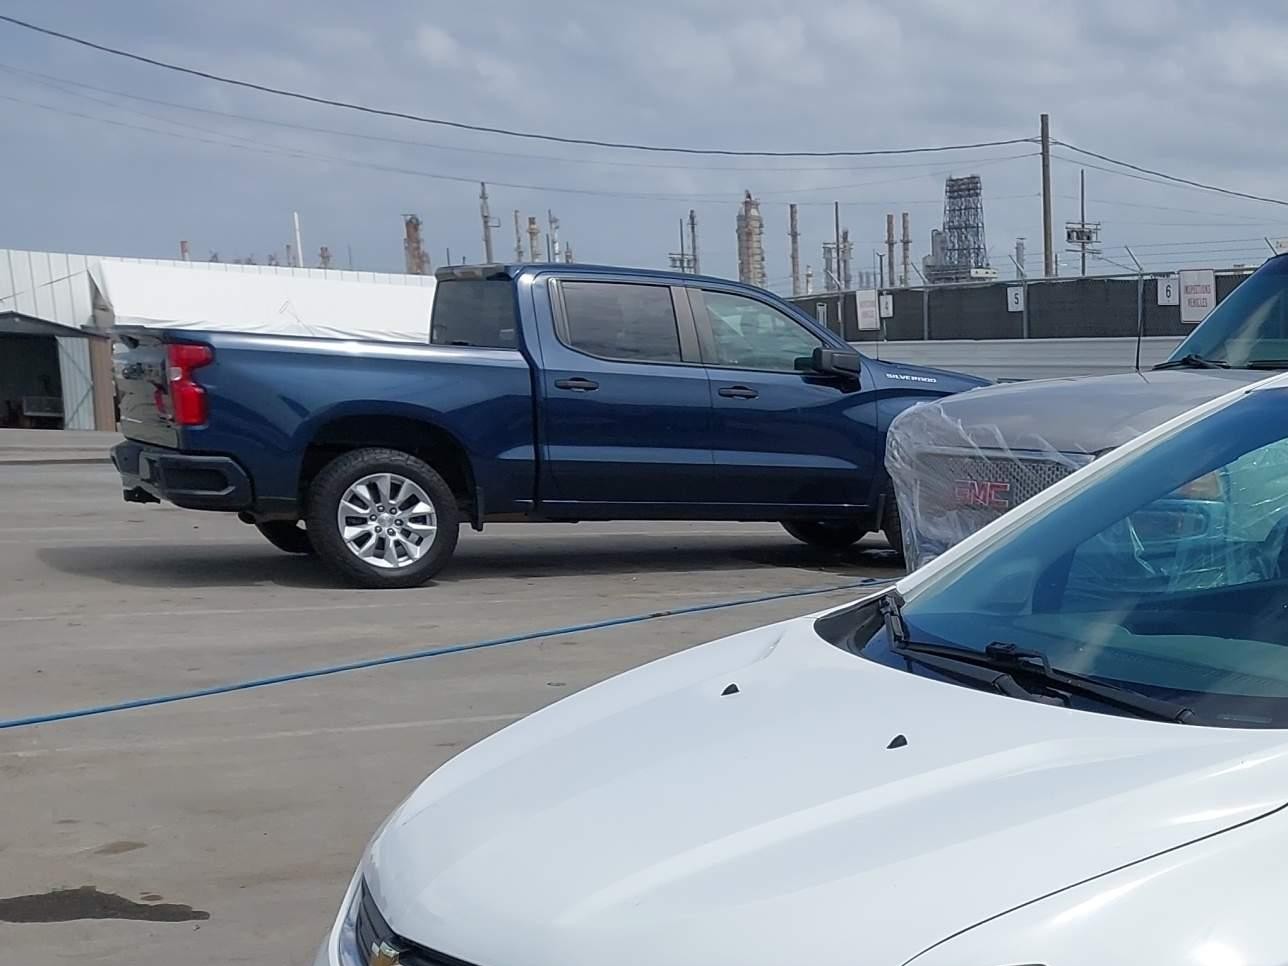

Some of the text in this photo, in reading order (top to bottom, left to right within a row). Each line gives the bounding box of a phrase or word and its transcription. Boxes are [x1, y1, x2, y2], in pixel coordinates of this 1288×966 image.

[1165, 284, 1172, 298] 6
[1014, 292, 1019, 305] 5
[954, 479, 1010, 508] GMC
